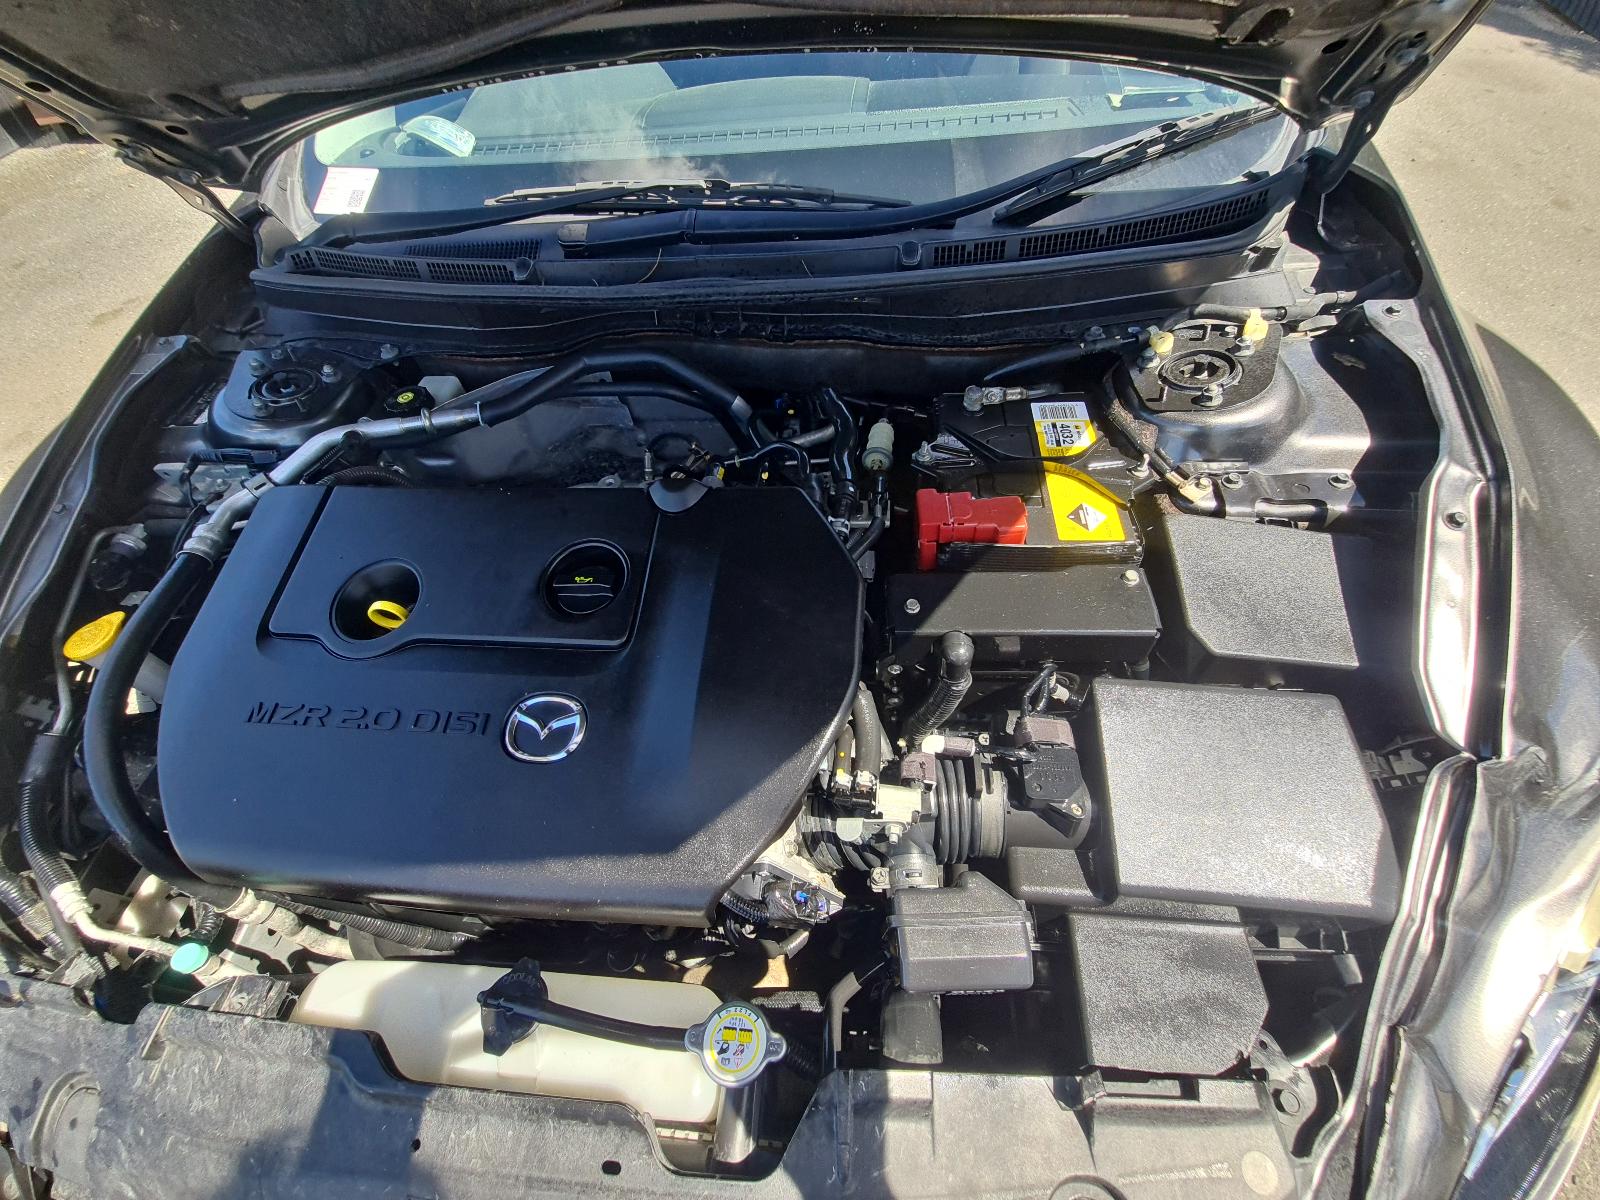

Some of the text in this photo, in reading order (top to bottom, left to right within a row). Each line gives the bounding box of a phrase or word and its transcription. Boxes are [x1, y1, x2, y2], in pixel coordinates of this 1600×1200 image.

[1060, 423, 1074, 445] 4032
[246, 702, 492, 735] MZR 2.0 DISI
